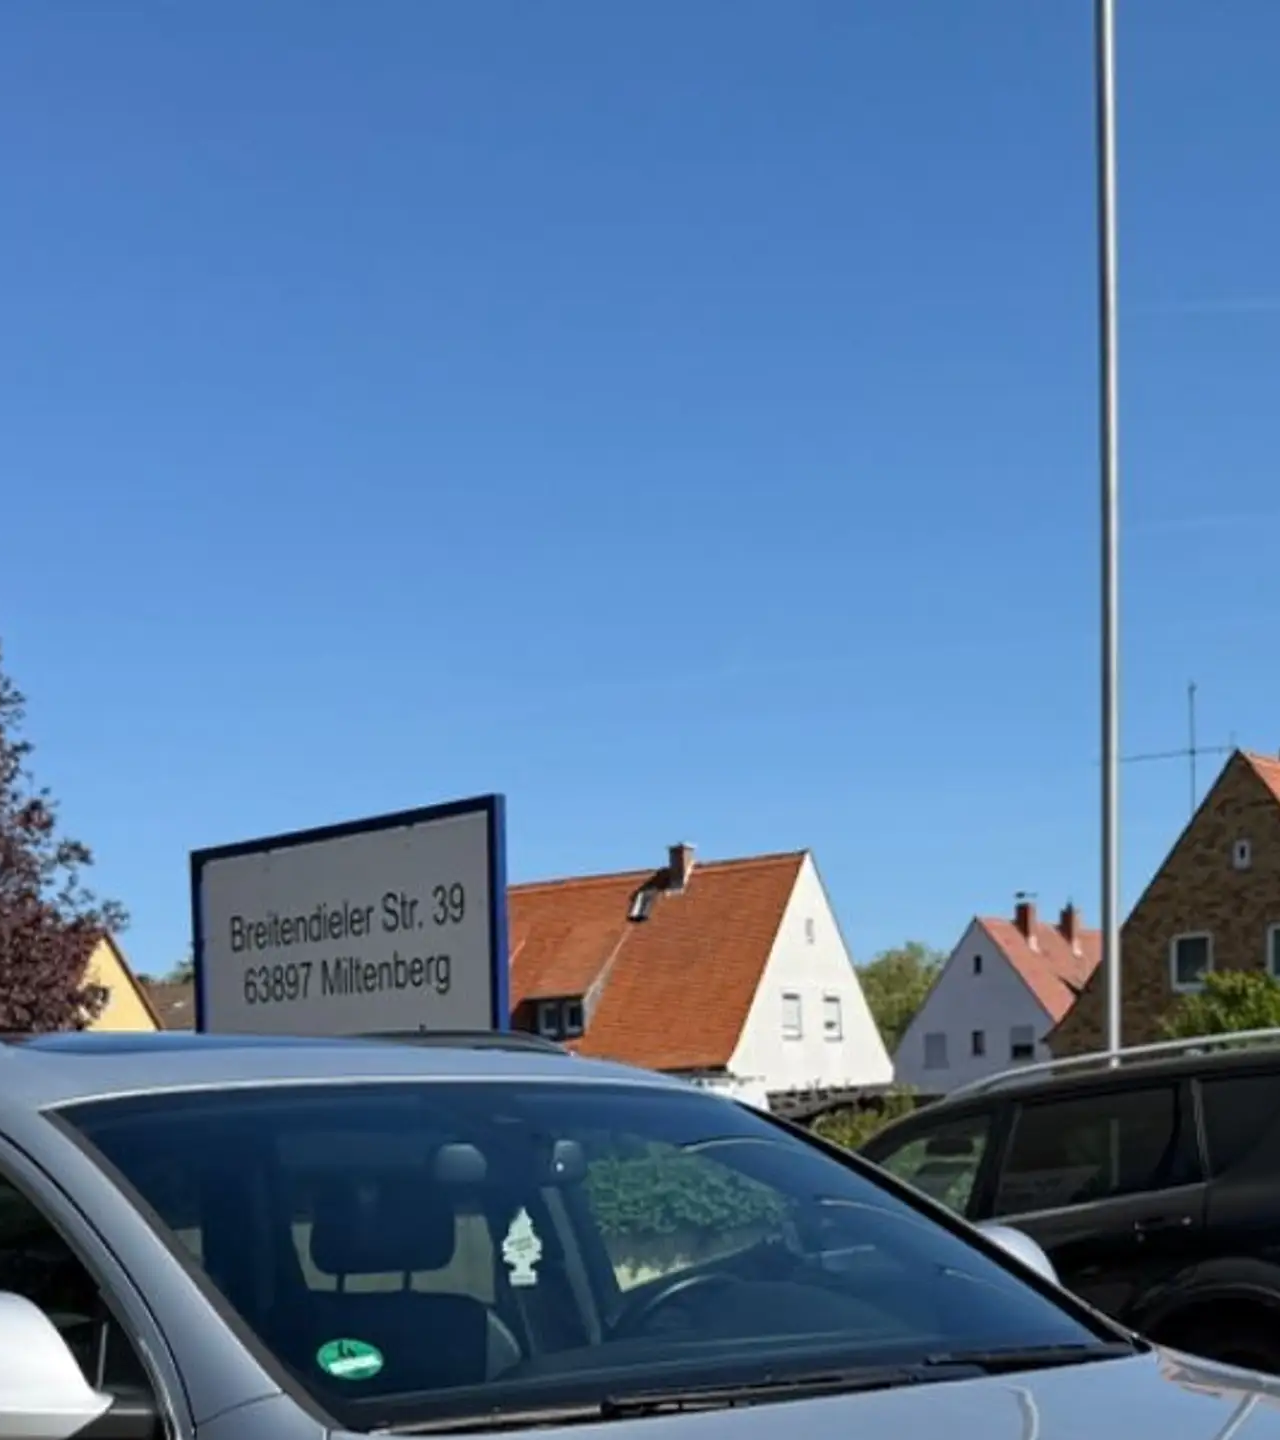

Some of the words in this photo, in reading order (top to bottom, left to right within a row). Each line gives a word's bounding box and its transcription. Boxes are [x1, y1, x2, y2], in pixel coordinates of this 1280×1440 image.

[230, 899, 374, 953] Breitendieler
[382, 892, 424, 933] Str.
[432, 882, 464, 926] 39
[244, 961, 313, 1005] 63897
[320, 950, 451, 996] Miltenberg
